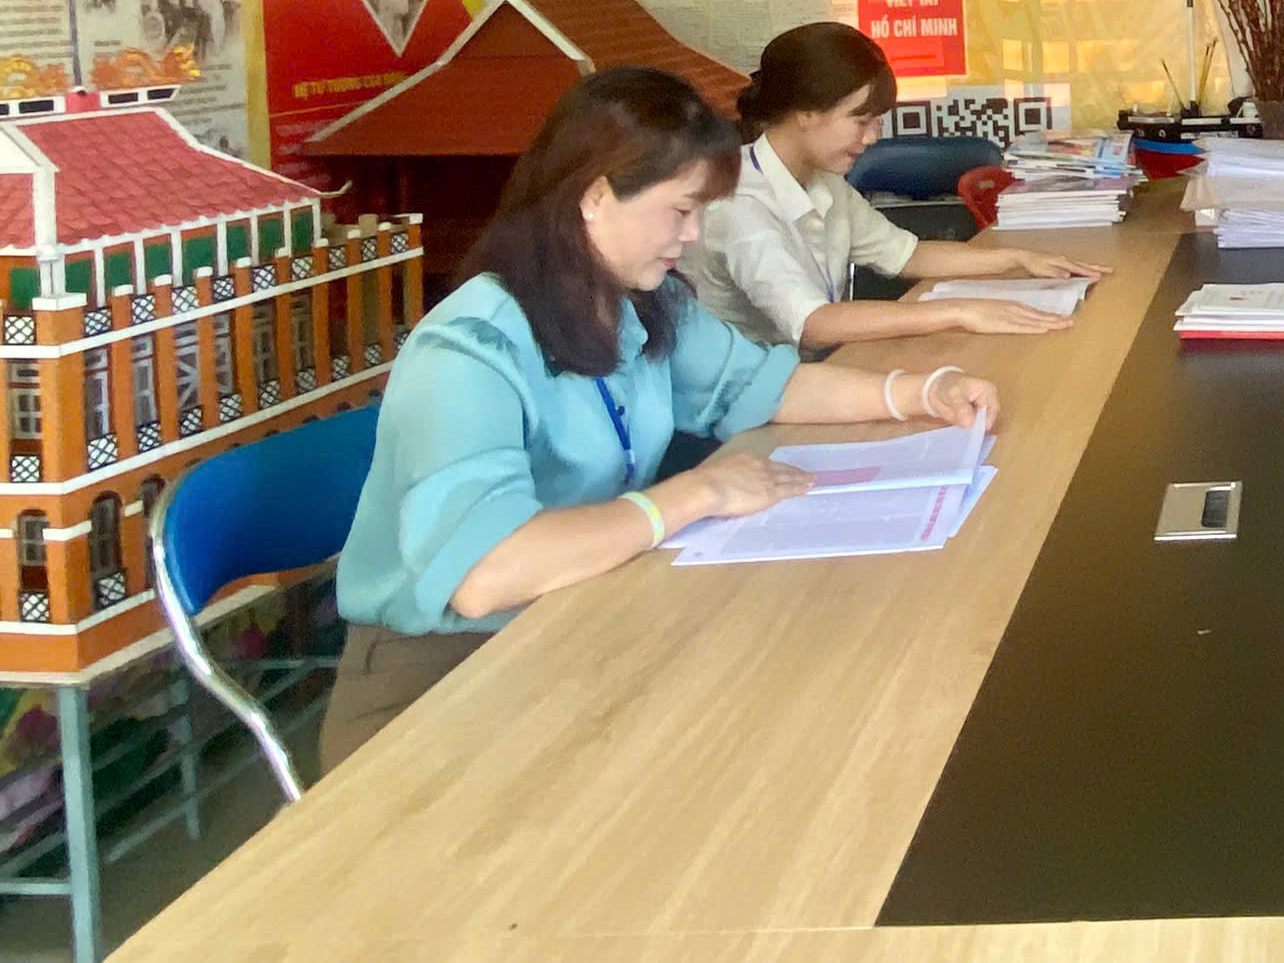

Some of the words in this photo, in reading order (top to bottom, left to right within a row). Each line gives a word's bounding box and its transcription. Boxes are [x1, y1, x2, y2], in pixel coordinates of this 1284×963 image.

[871, 16, 891, 38] HỒ
[894, 15, 918, 38] CHÍ
[920, 18, 958, 37] MINH
